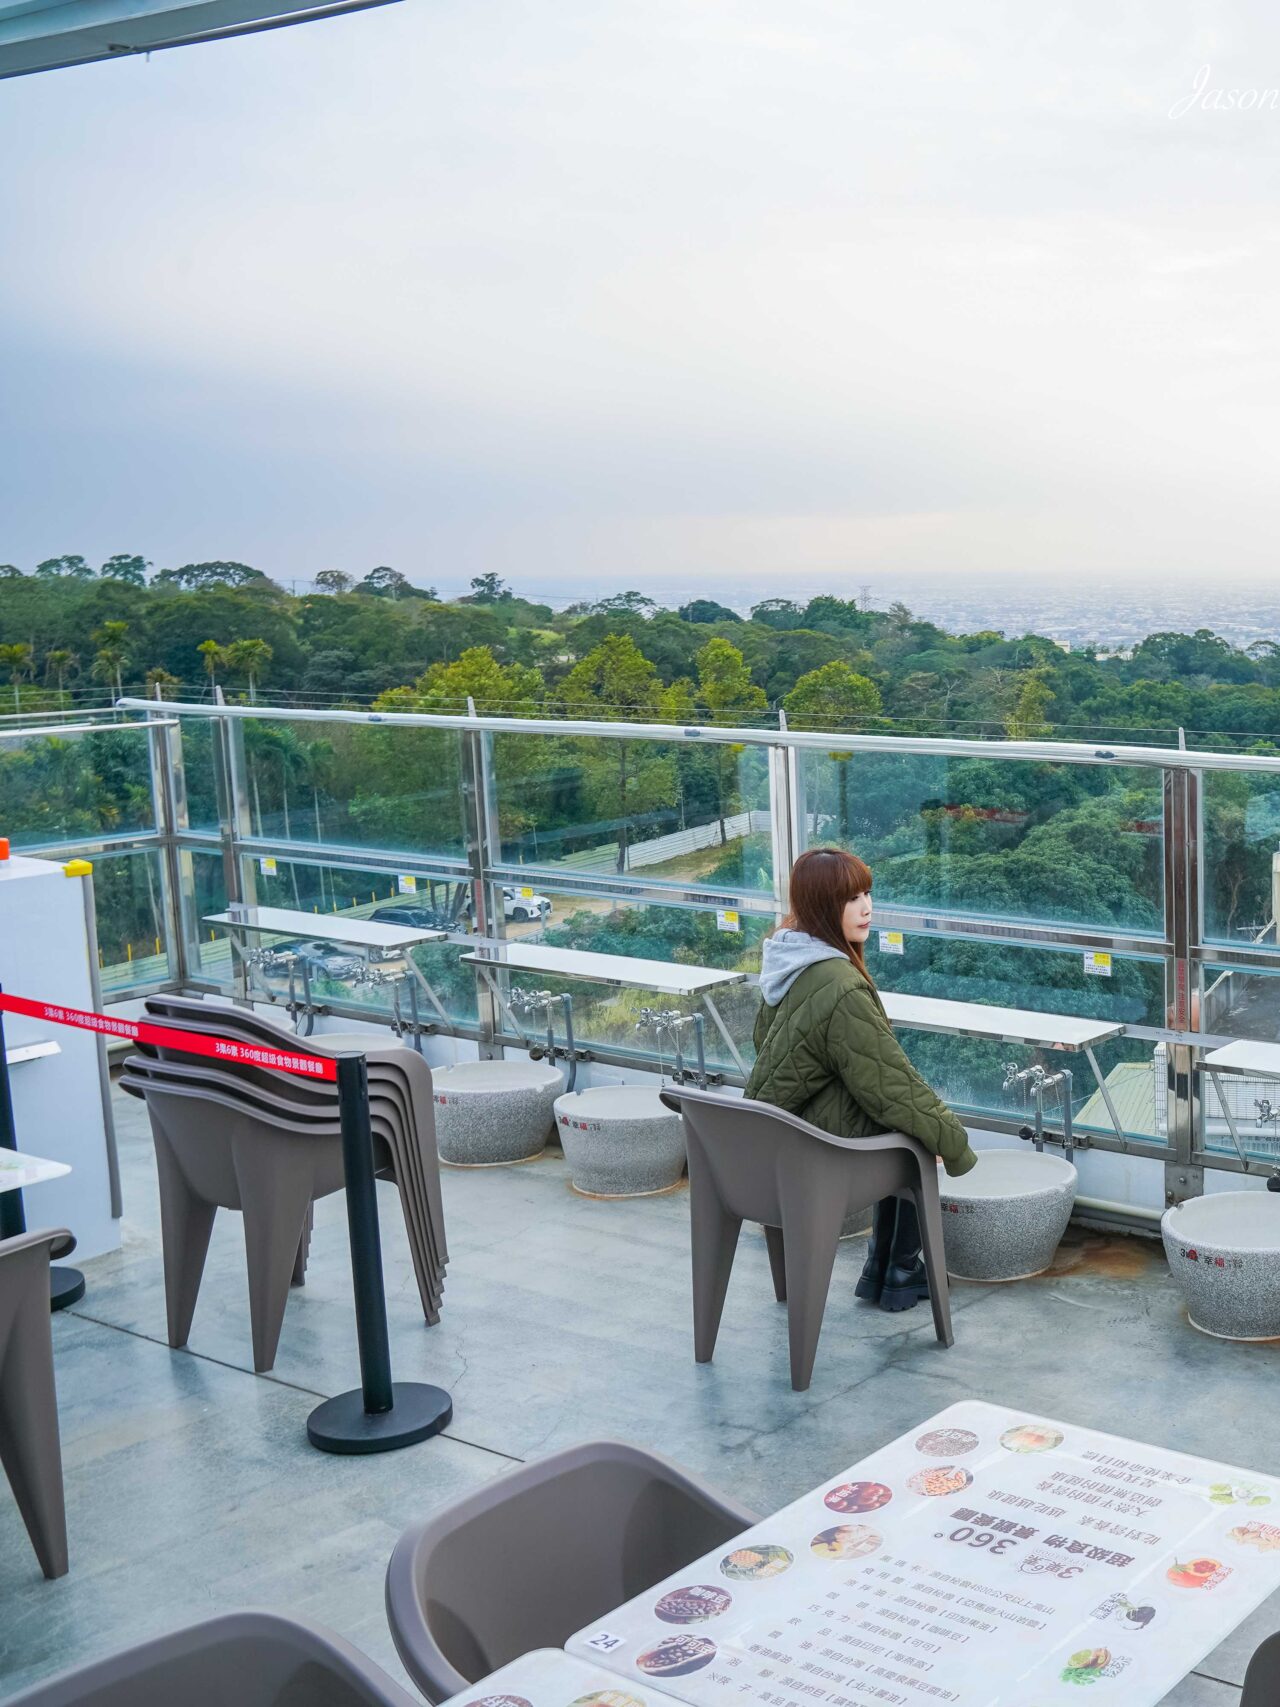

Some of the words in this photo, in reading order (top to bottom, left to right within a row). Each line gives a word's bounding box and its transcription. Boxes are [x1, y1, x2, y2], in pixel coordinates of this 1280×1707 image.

[1042, 1534, 1135, 1568] 超級食物
[589, 1634, 619, 1651] 24
